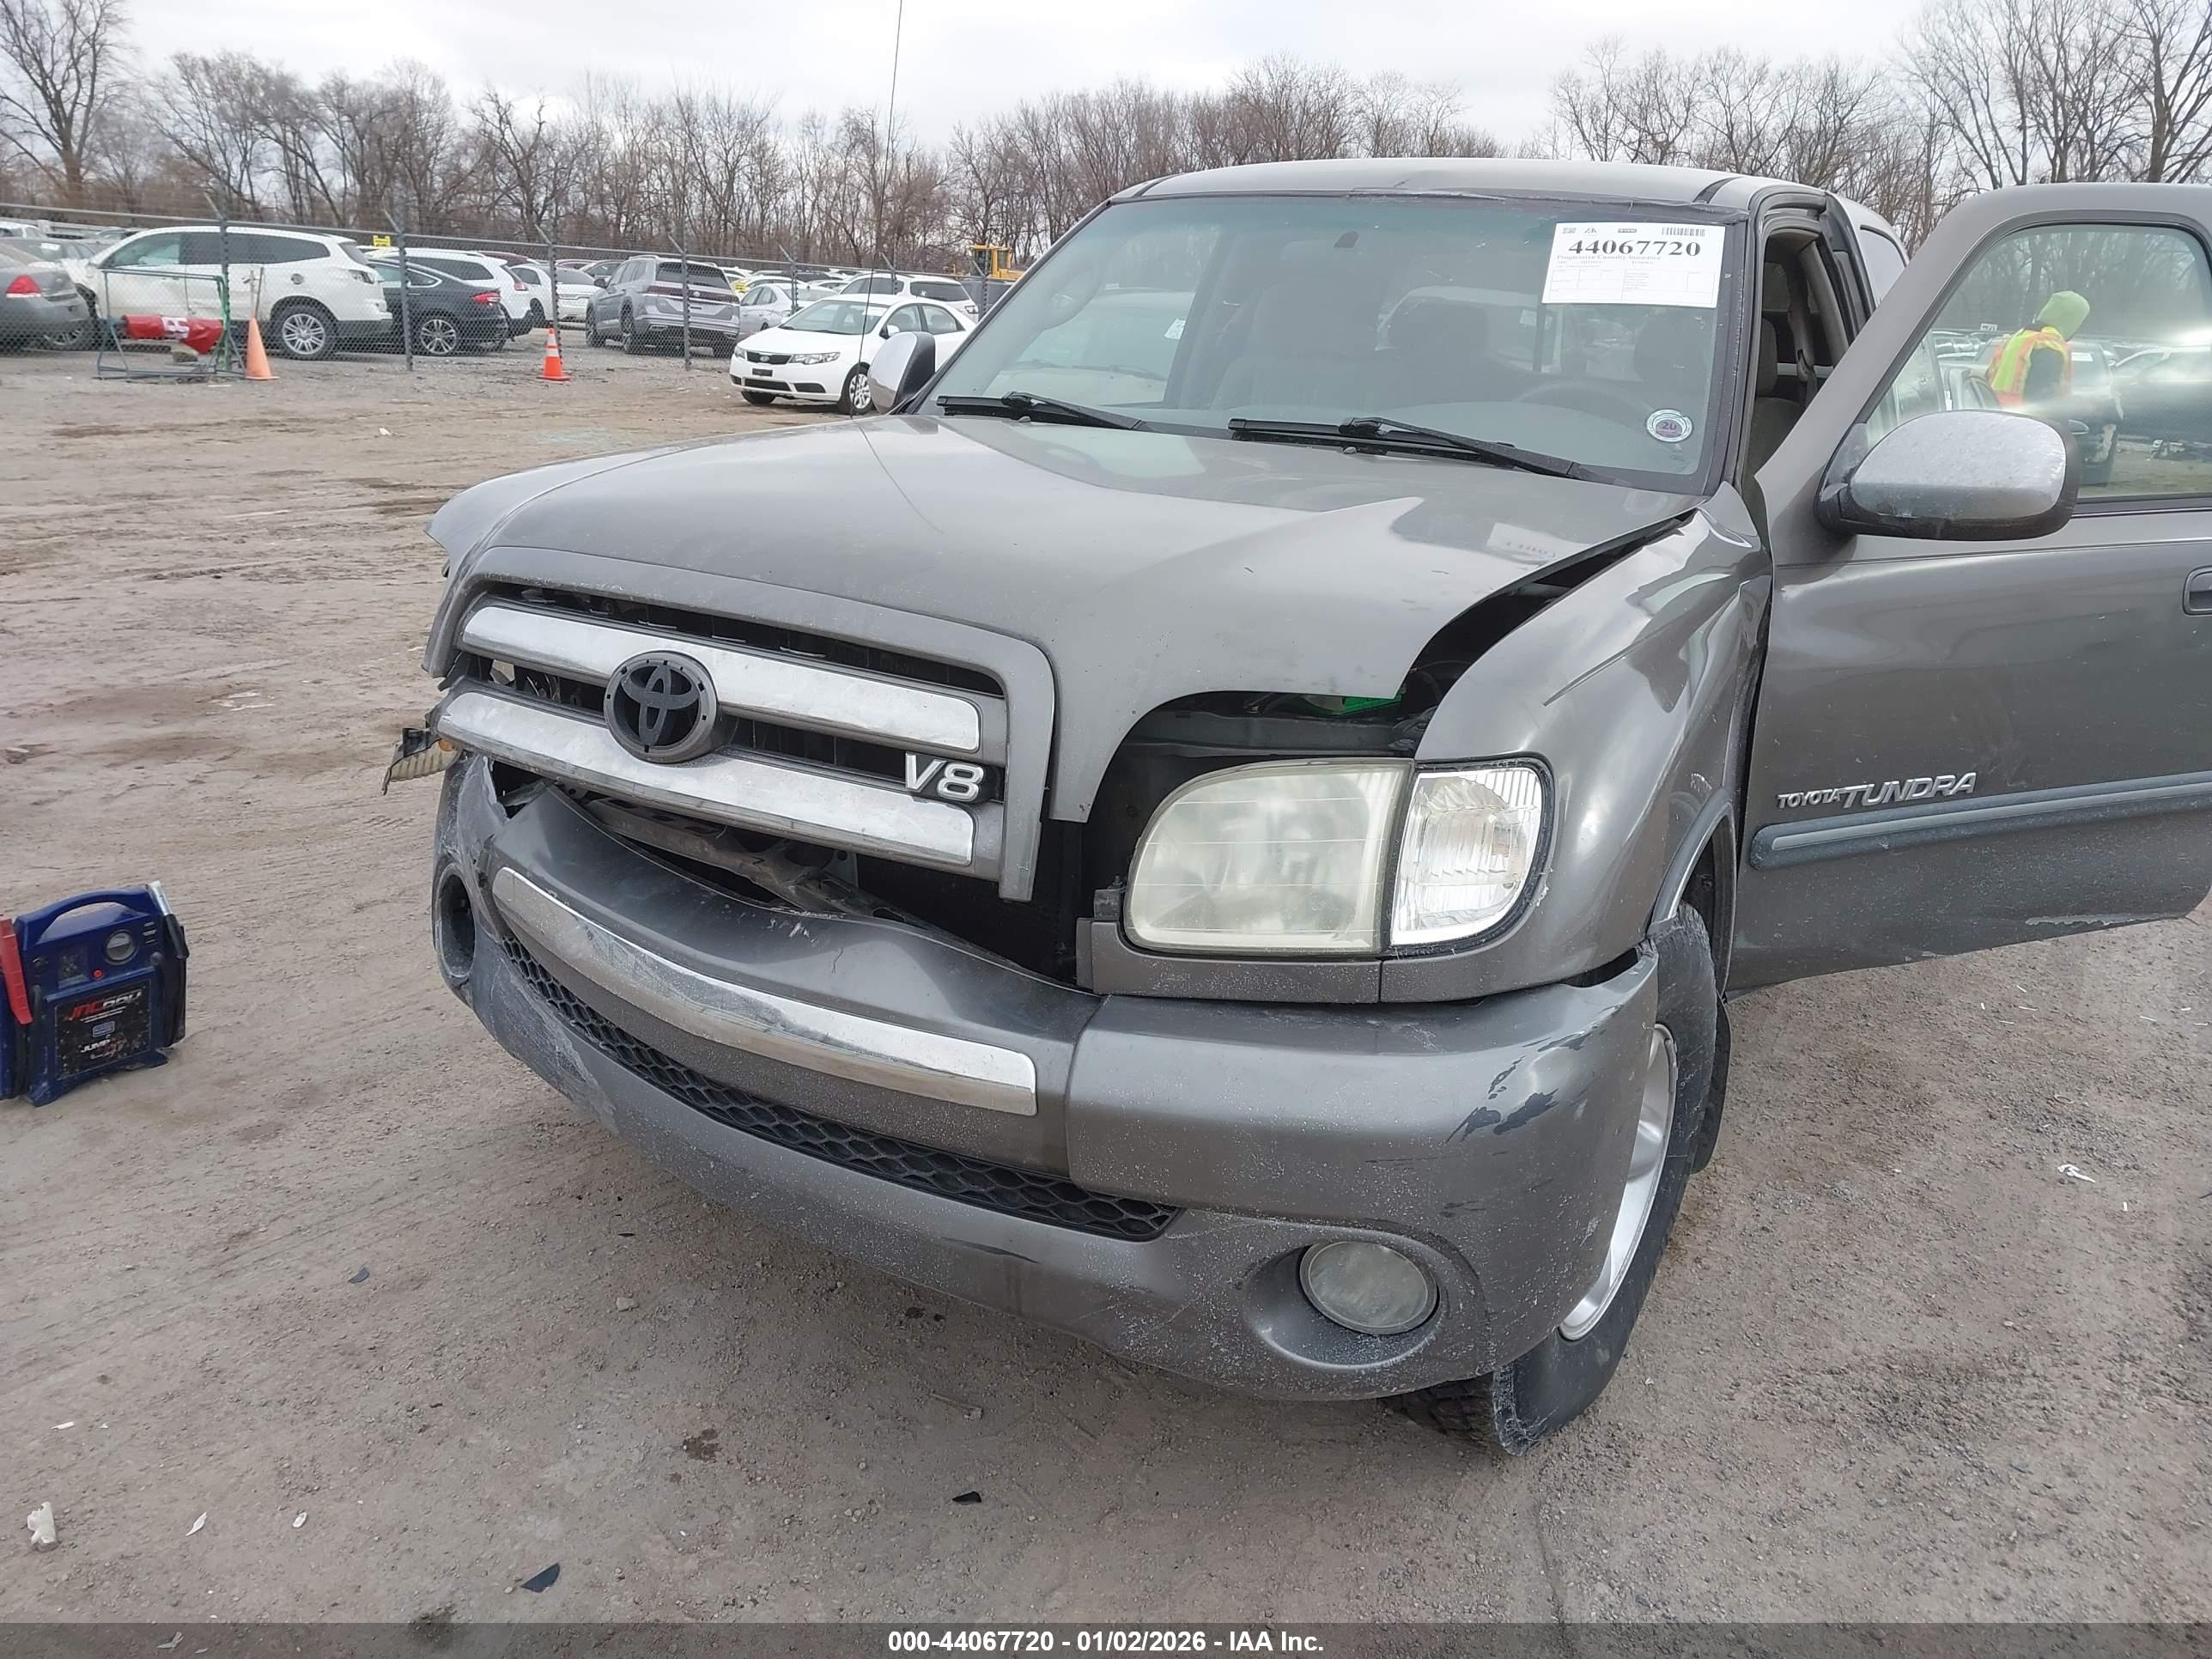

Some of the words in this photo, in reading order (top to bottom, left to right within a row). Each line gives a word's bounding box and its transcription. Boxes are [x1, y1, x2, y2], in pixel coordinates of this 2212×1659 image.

[1568, 240, 1701, 257] 44067720
[905, 751, 984, 802] V8
[1778, 787, 1841, 809] TOYOTA
[1838, 772, 1977, 809] TUNDRA
